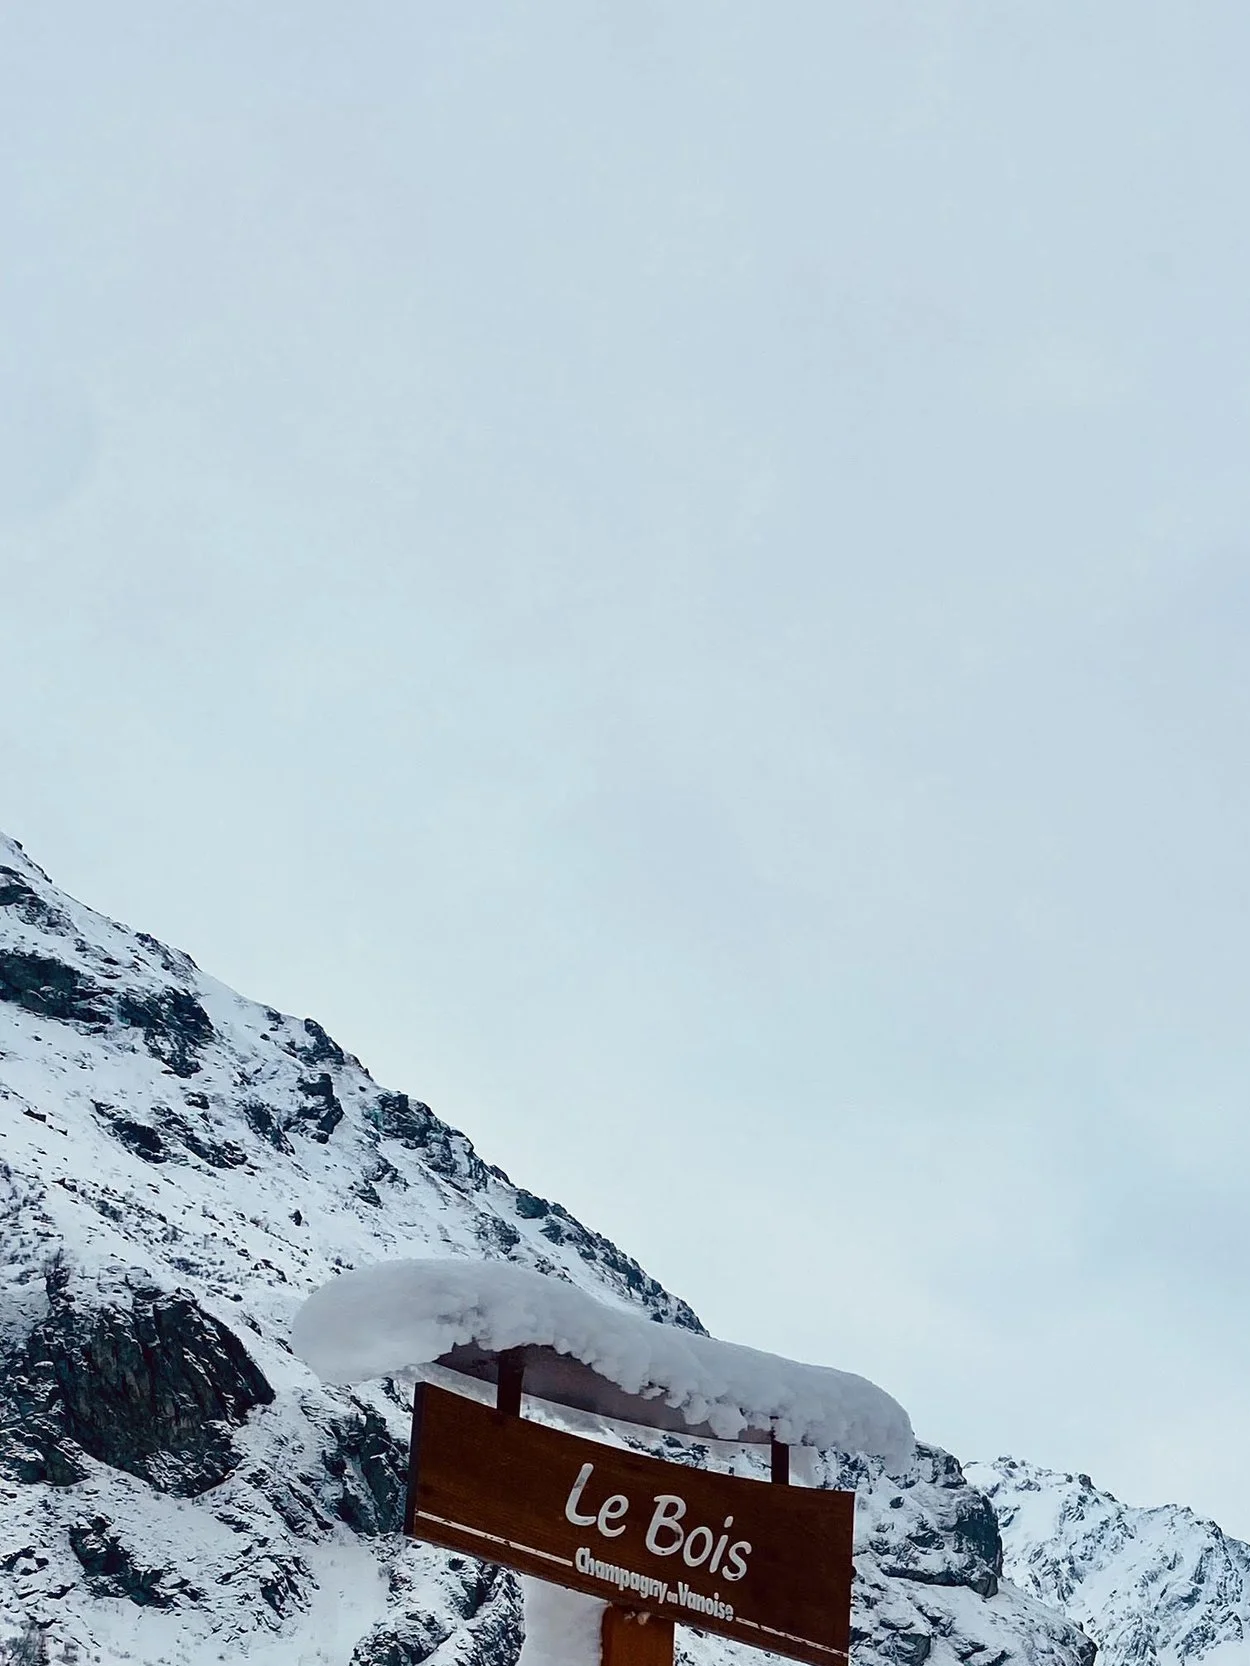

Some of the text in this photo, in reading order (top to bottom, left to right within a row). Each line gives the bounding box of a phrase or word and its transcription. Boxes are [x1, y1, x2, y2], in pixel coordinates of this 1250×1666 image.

[565, 1462, 752, 1582] Le Bois
[575, 1547, 668, 1604] Champagny
[678, 1582, 734, 1621] Vanoise
